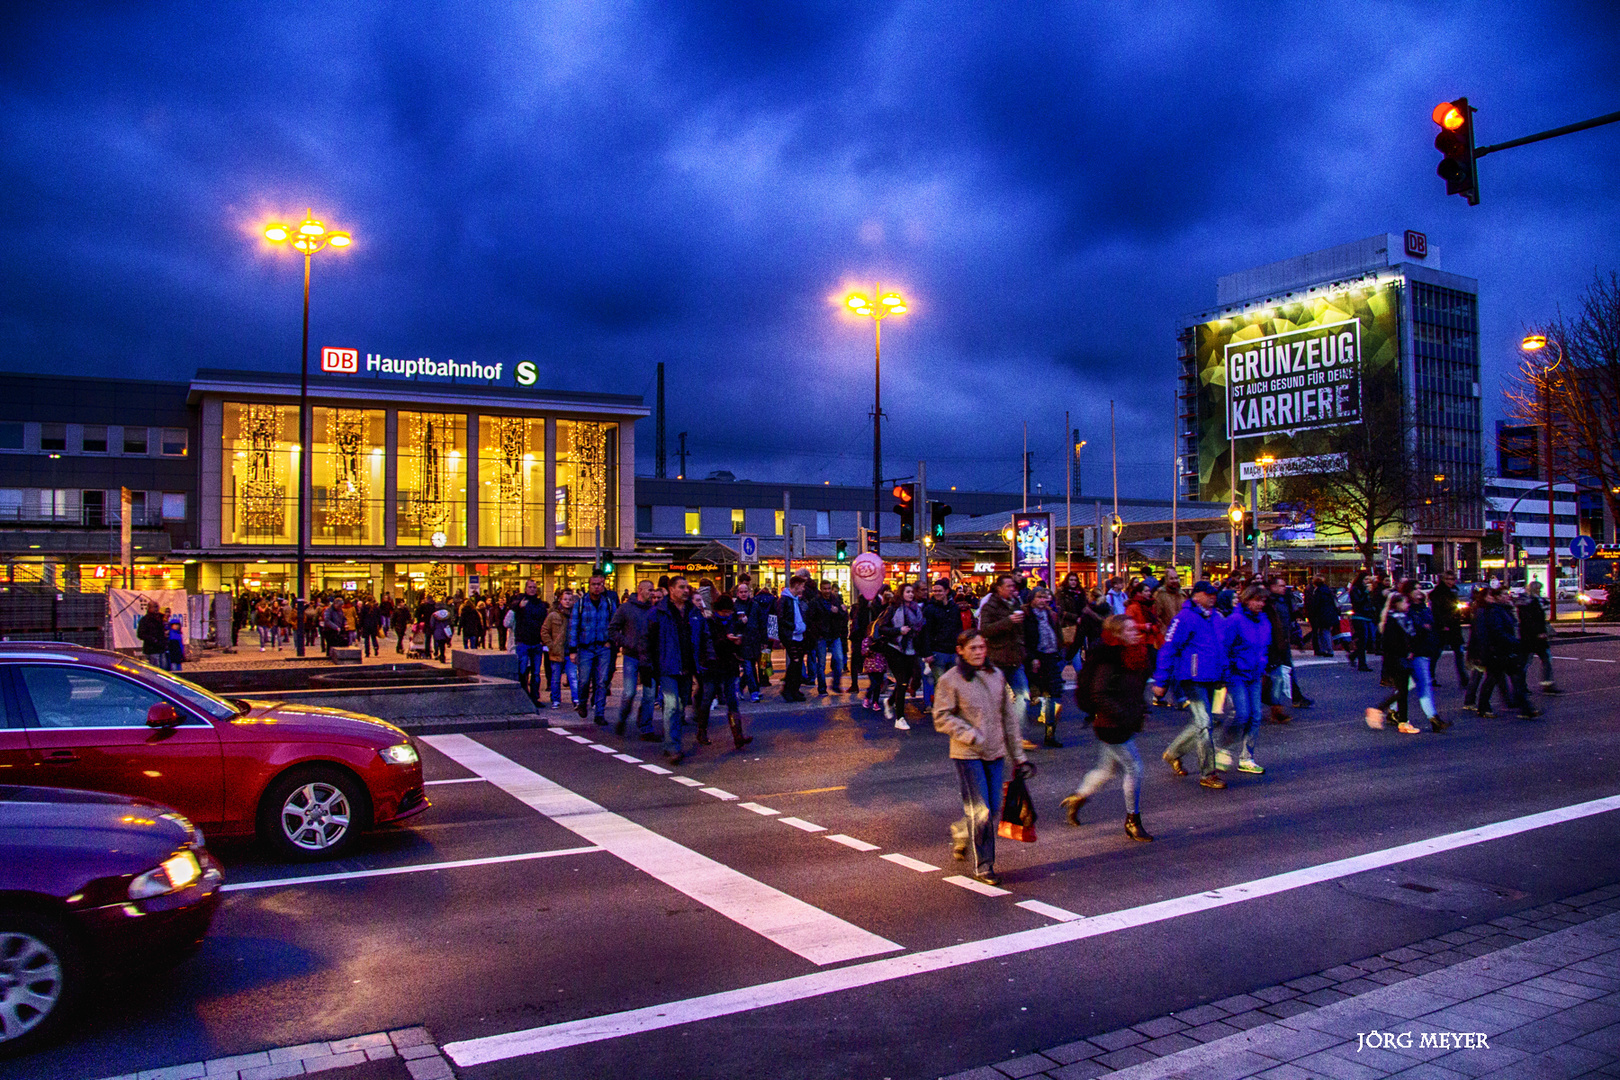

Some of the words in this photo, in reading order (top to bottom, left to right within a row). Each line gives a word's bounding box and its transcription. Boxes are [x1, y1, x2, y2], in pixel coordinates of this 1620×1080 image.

[1409, 234, 1425, 252] DB
[327, 351, 354, 369] DB
[366, 353, 503, 380] Hauptbahnhof
[1230, 332, 1354, 383] GRÜNZEUG
[517, 362, 537, 385] S
[1246, 381, 1269, 395] AUCH
[1270, 375, 1305, 391] GESUND
[1307, 370, 1325, 385] FÜR
[1327, 367, 1354, 381] DEINE
[1232, 384, 1357, 431] KARRIERE.
[1243, 465, 1262, 476] MACH
[974, 563, 996, 572] KFC
